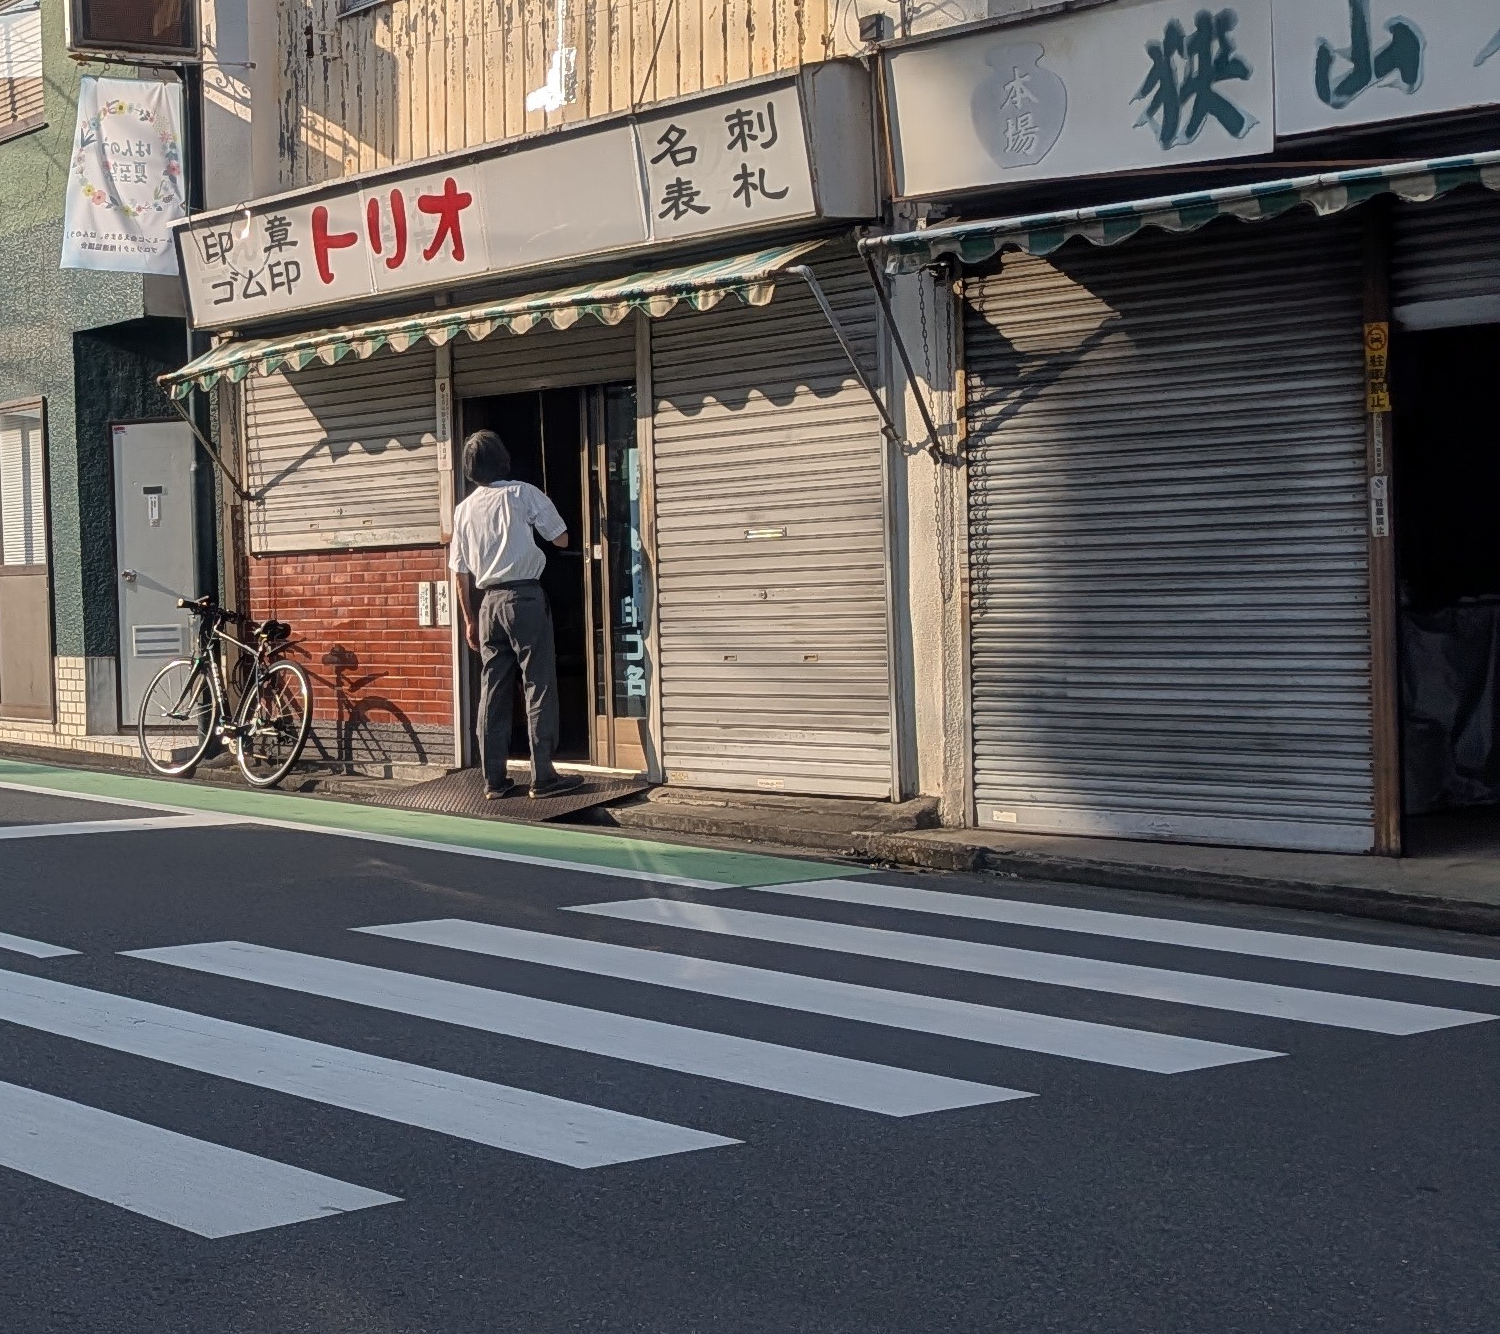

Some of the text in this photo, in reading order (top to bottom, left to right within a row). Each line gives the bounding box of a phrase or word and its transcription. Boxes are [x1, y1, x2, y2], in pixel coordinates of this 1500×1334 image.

[650, 101, 778, 167] 名刺
[658, 162, 790, 221] 表札
[203, 216, 299, 265] 印章
[311, 177, 472, 284] トリオ
[211, 260, 301, 306] ゴム印
